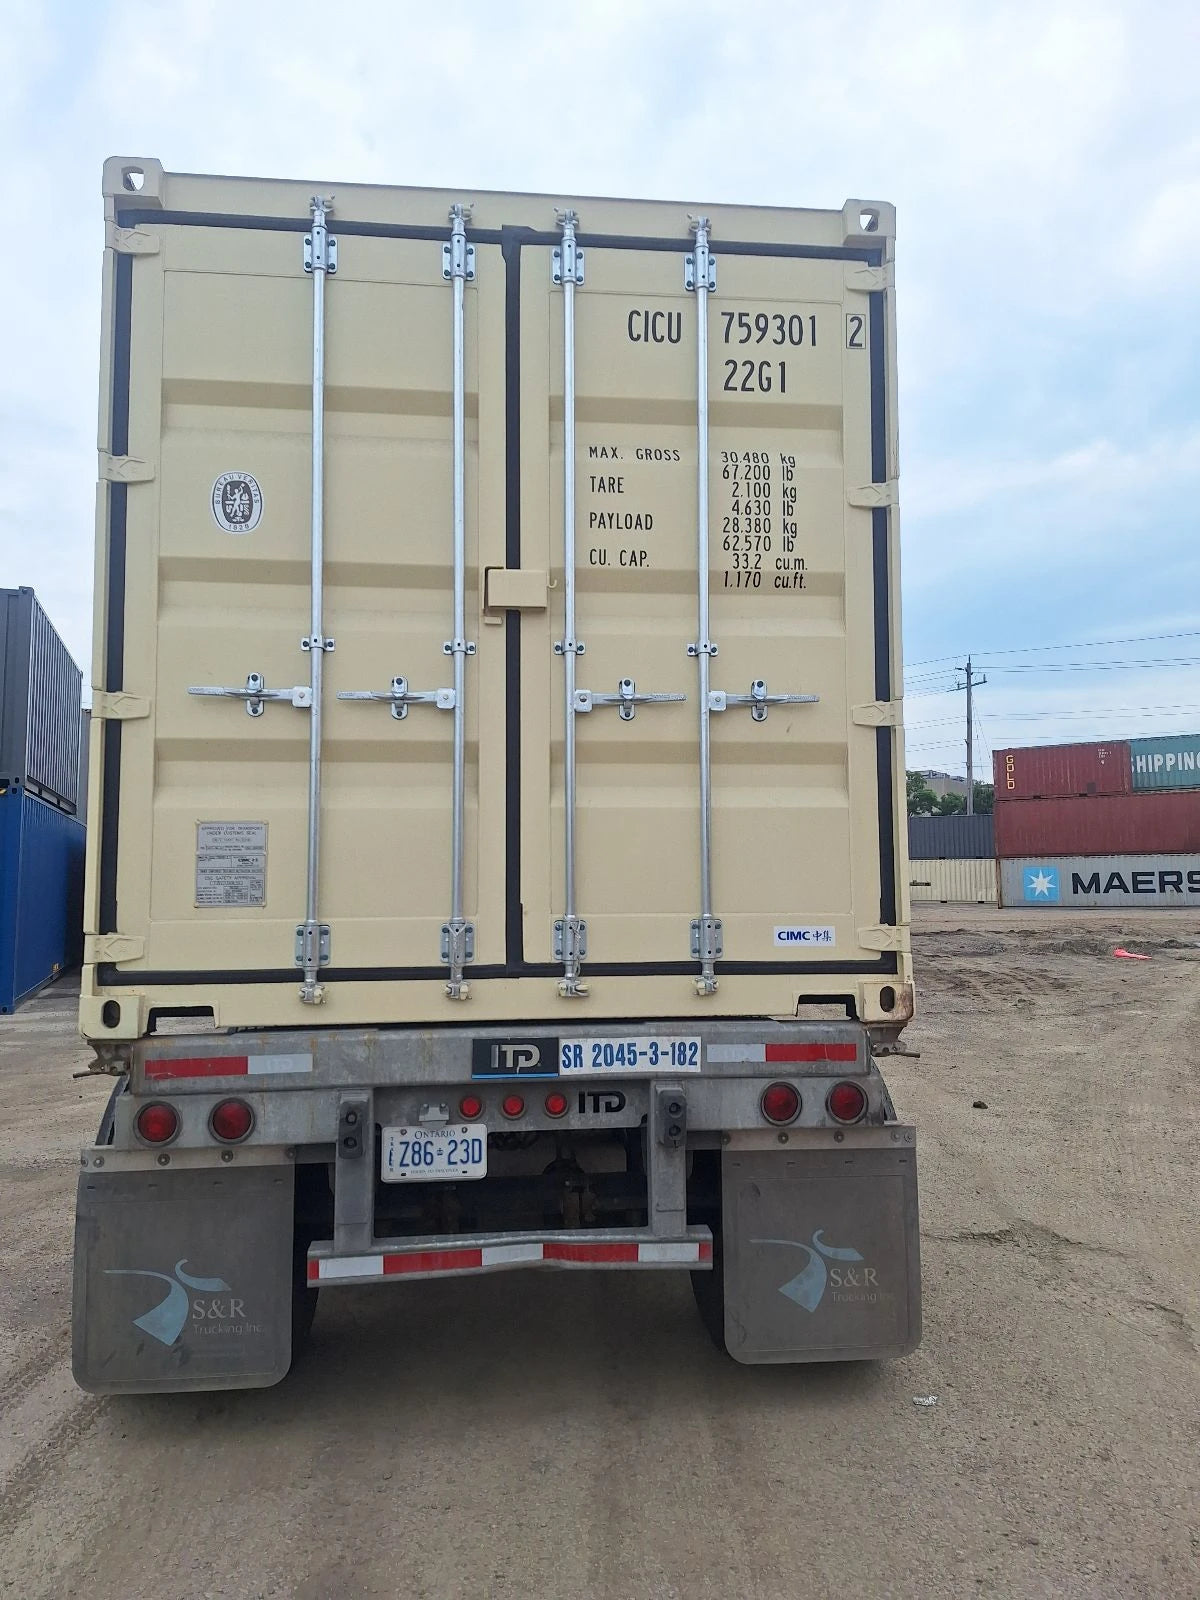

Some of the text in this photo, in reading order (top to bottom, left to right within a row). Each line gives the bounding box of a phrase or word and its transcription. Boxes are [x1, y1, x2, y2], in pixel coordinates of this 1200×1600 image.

[628, 310, 864, 348] CICU 759301 2
[723, 358, 787, 393] 22G1
[588, 446, 796, 468] MAX. GROSS 30.480 kg
[721, 464, 794, 482] 67.200 lb
[589, 476, 798, 501] TARE 2.100 kg
[731, 500, 795, 517] 4.630 lb
[589, 512, 798, 538] PAYLOAD 28.380 kg
[722, 535, 795, 553] 62.570 lb
[589, 549, 808, 571] CU. CAP. 33.2 cu.m.
[723, 570, 807, 589] 1.170 cu.ft.
[1006, 755, 1015, 790] GOLD
[1131, 751, 1200, 774] HIPPIN
[777, 931, 811, 941] CIMC
[562, 1044, 584, 1069] SR
[592, 1041, 699, 1067] 2045-3-182
[414, 1129, 456, 1140] ONTARIO
[399, 1138, 483, 1168] Z86 23D
[829, 1267, 879, 1288] S&R
[192, 1299, 247, 1320] S&R
[194, 1323, 243, 1335] Trucking
